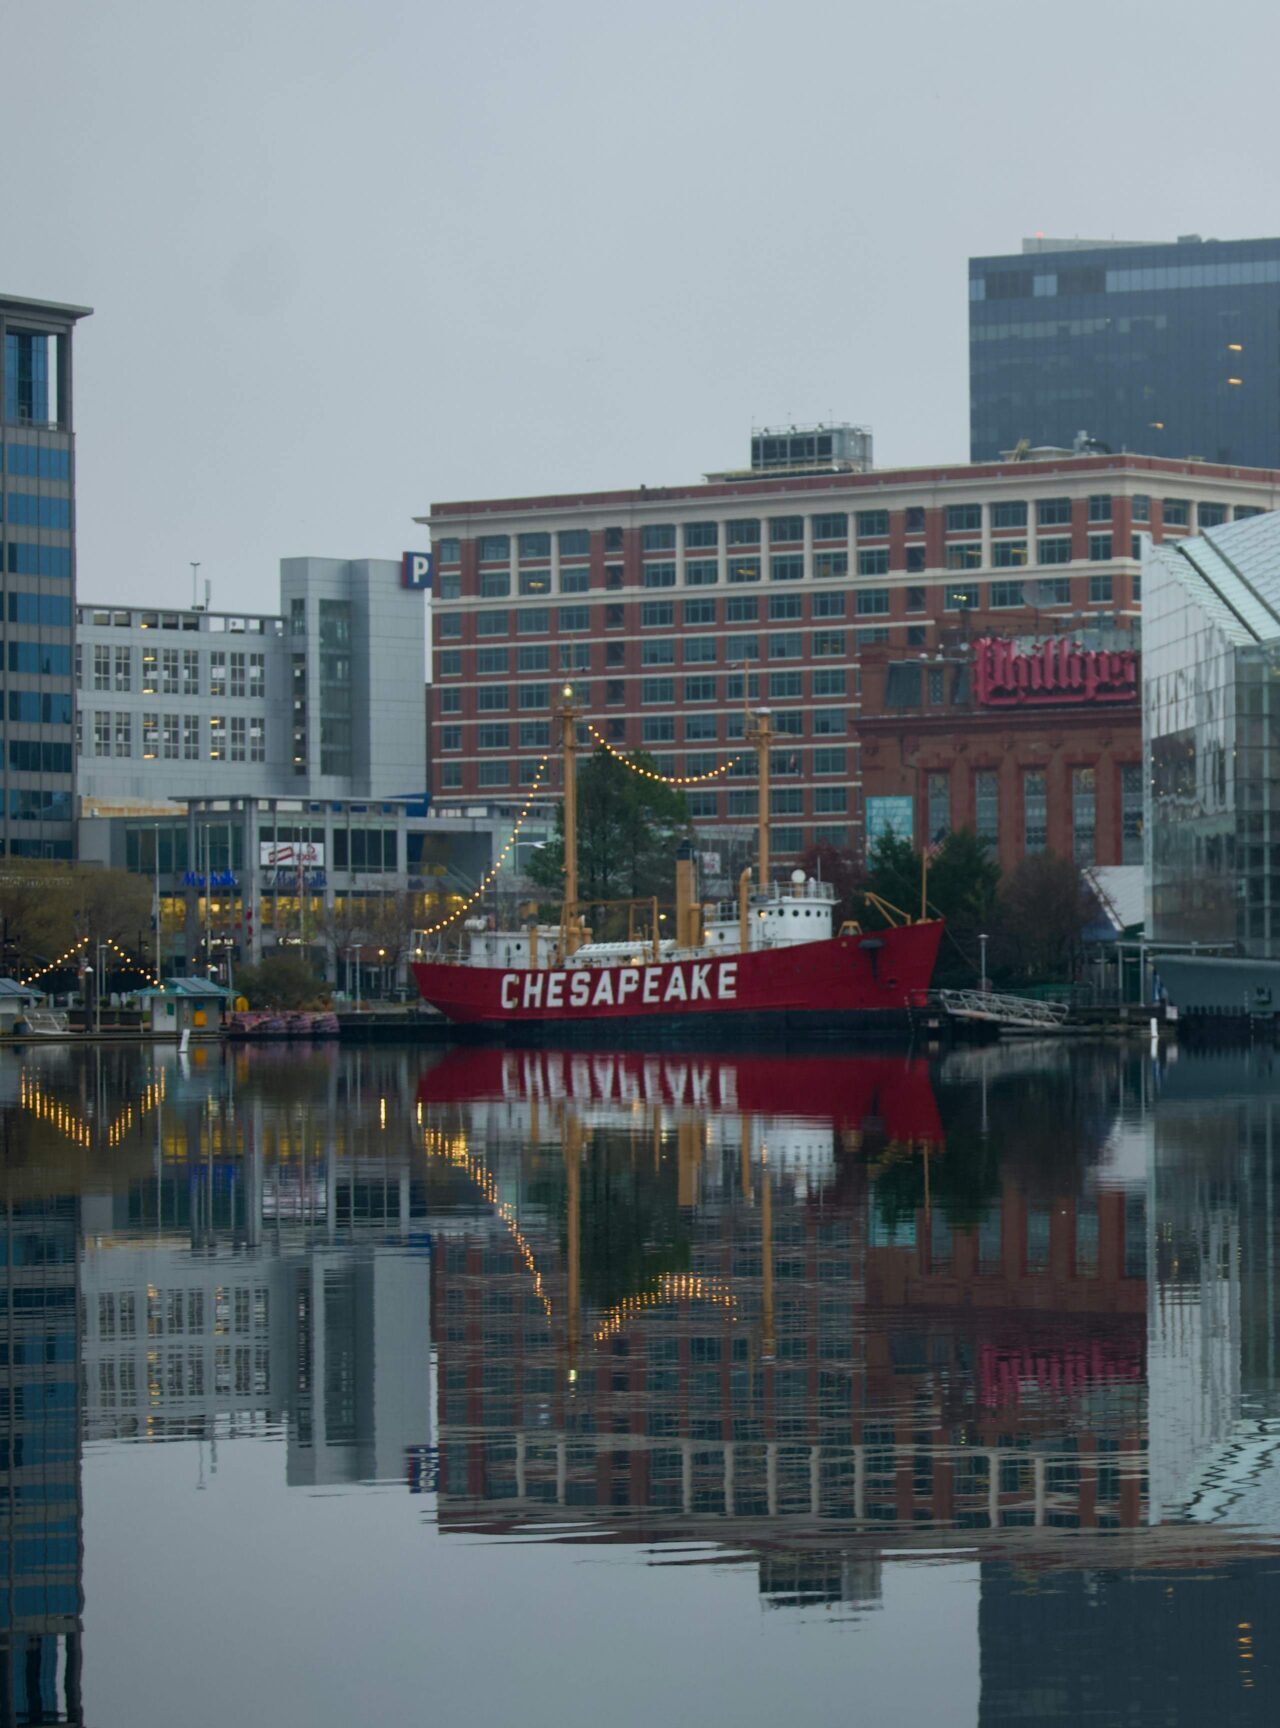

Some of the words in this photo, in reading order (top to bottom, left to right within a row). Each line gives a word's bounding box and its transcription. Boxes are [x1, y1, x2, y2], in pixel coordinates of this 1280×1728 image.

[412, 556, 429, 583] P
[969, 637, 1137, 705] Phillips
[501, 962, 738, 1010] CHESAPEAKE
